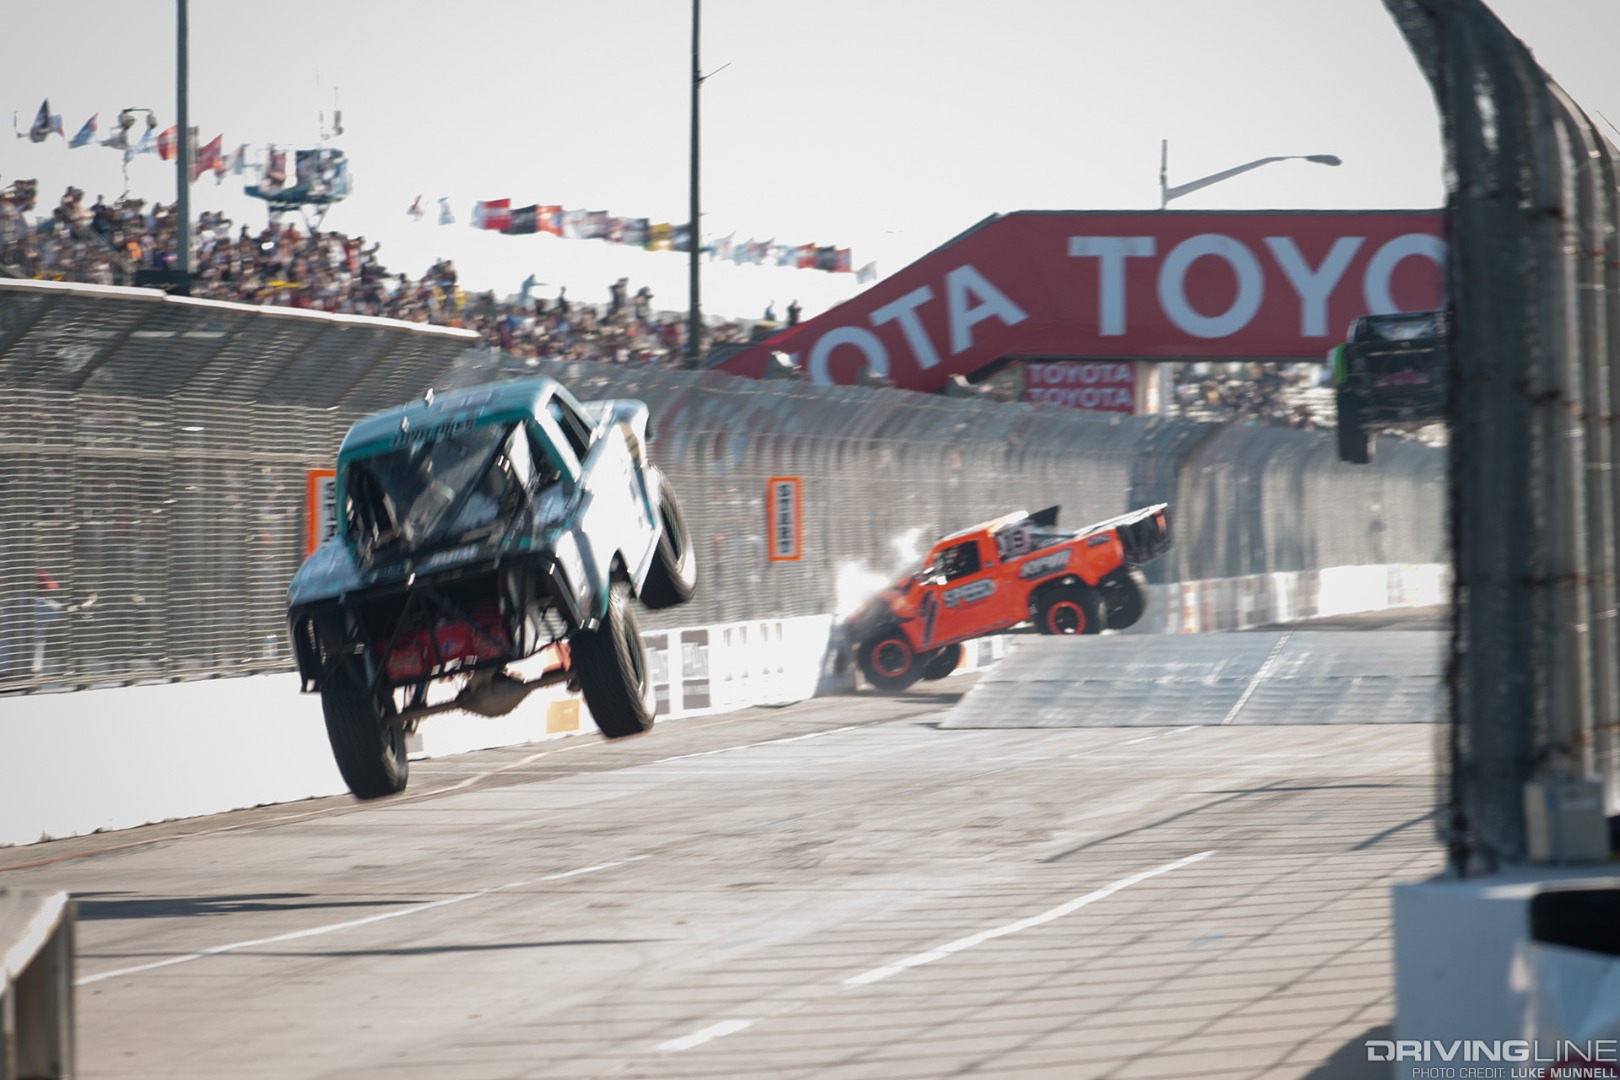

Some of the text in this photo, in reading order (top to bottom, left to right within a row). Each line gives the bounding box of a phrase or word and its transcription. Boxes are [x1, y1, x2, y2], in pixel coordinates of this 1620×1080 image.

[796, 263, 1029, 386] OTA
[1027, 363, 1133, 384] TOYOTA
[1027, 387, 1133, 408] TOYOTA
[942, 578, 996, 608] SPEED
